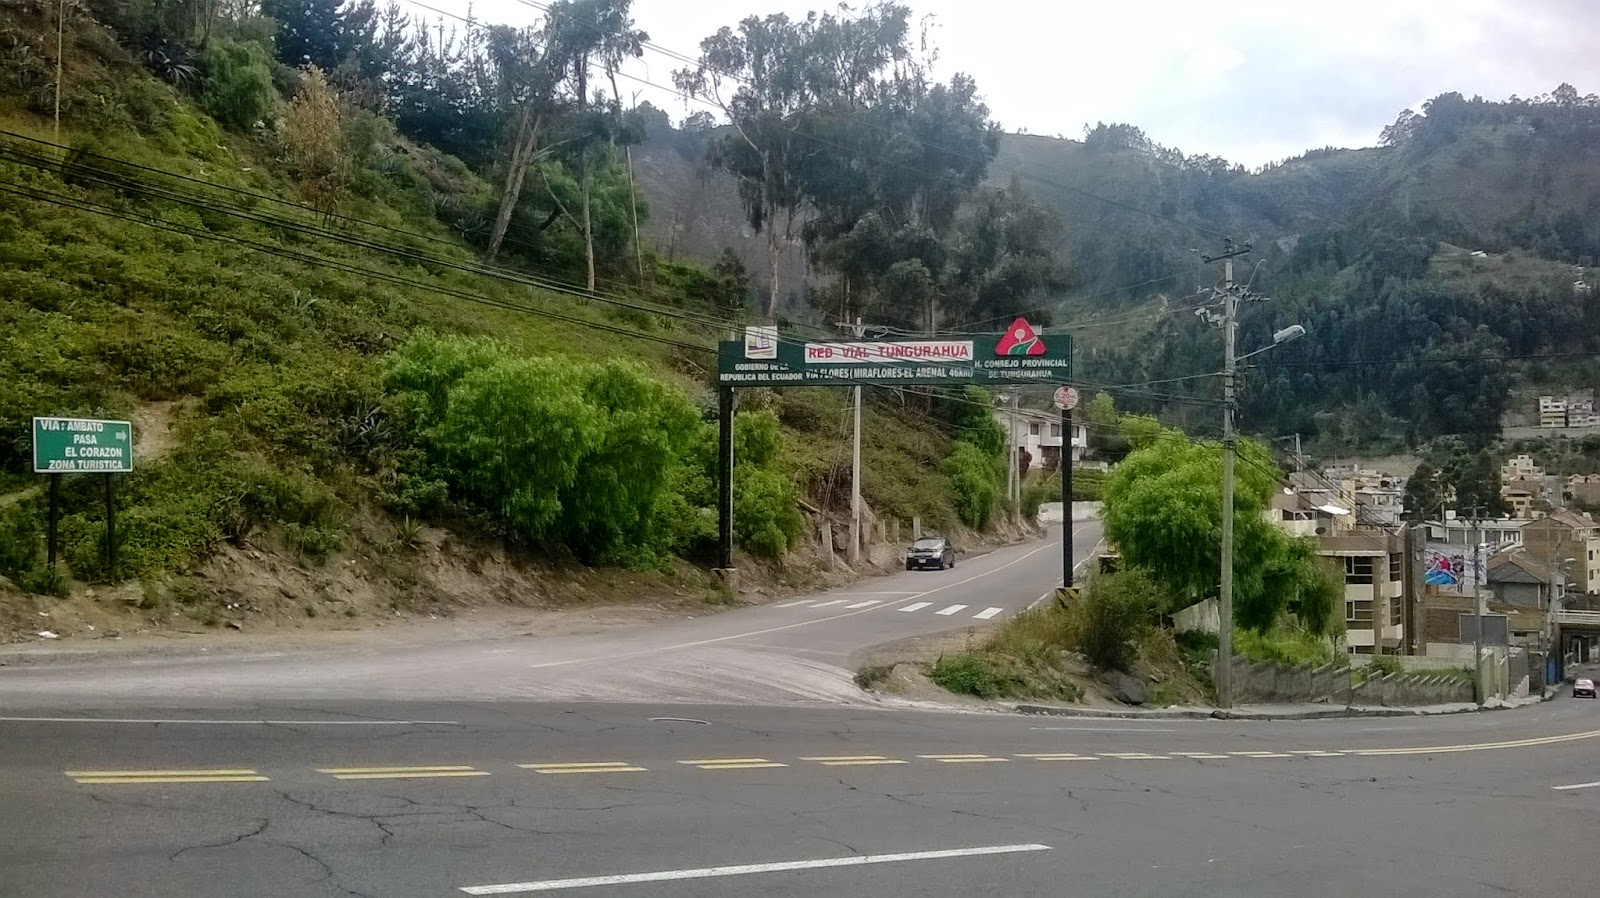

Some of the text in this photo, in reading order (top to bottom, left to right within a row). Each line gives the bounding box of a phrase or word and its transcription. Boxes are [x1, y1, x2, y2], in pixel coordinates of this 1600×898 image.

[809, 345, 969, 359] RED VIAL TUNGURAHUA
[735, 363, 769, 371] GOBIERNO
[770, 363, 779, 371] DE
[984, 359, 1019, 368] CONSEJO
[1022, 359, 1067, 367] PROVINCIAL
[720, 373, 803, 381] REPUBLICA DEL ECUADOR
[916, 367, 946, 378] ARENAL
[988, 370, 1053, 379] DE TUNGURAHUA
[67, 421, 104, 432] AMBATO
[73, 434, 98, 445] PASA
[65, 447, 123, 457] EL CORAZON
[48, 460, 123, 470] ZONA TURISTICA
